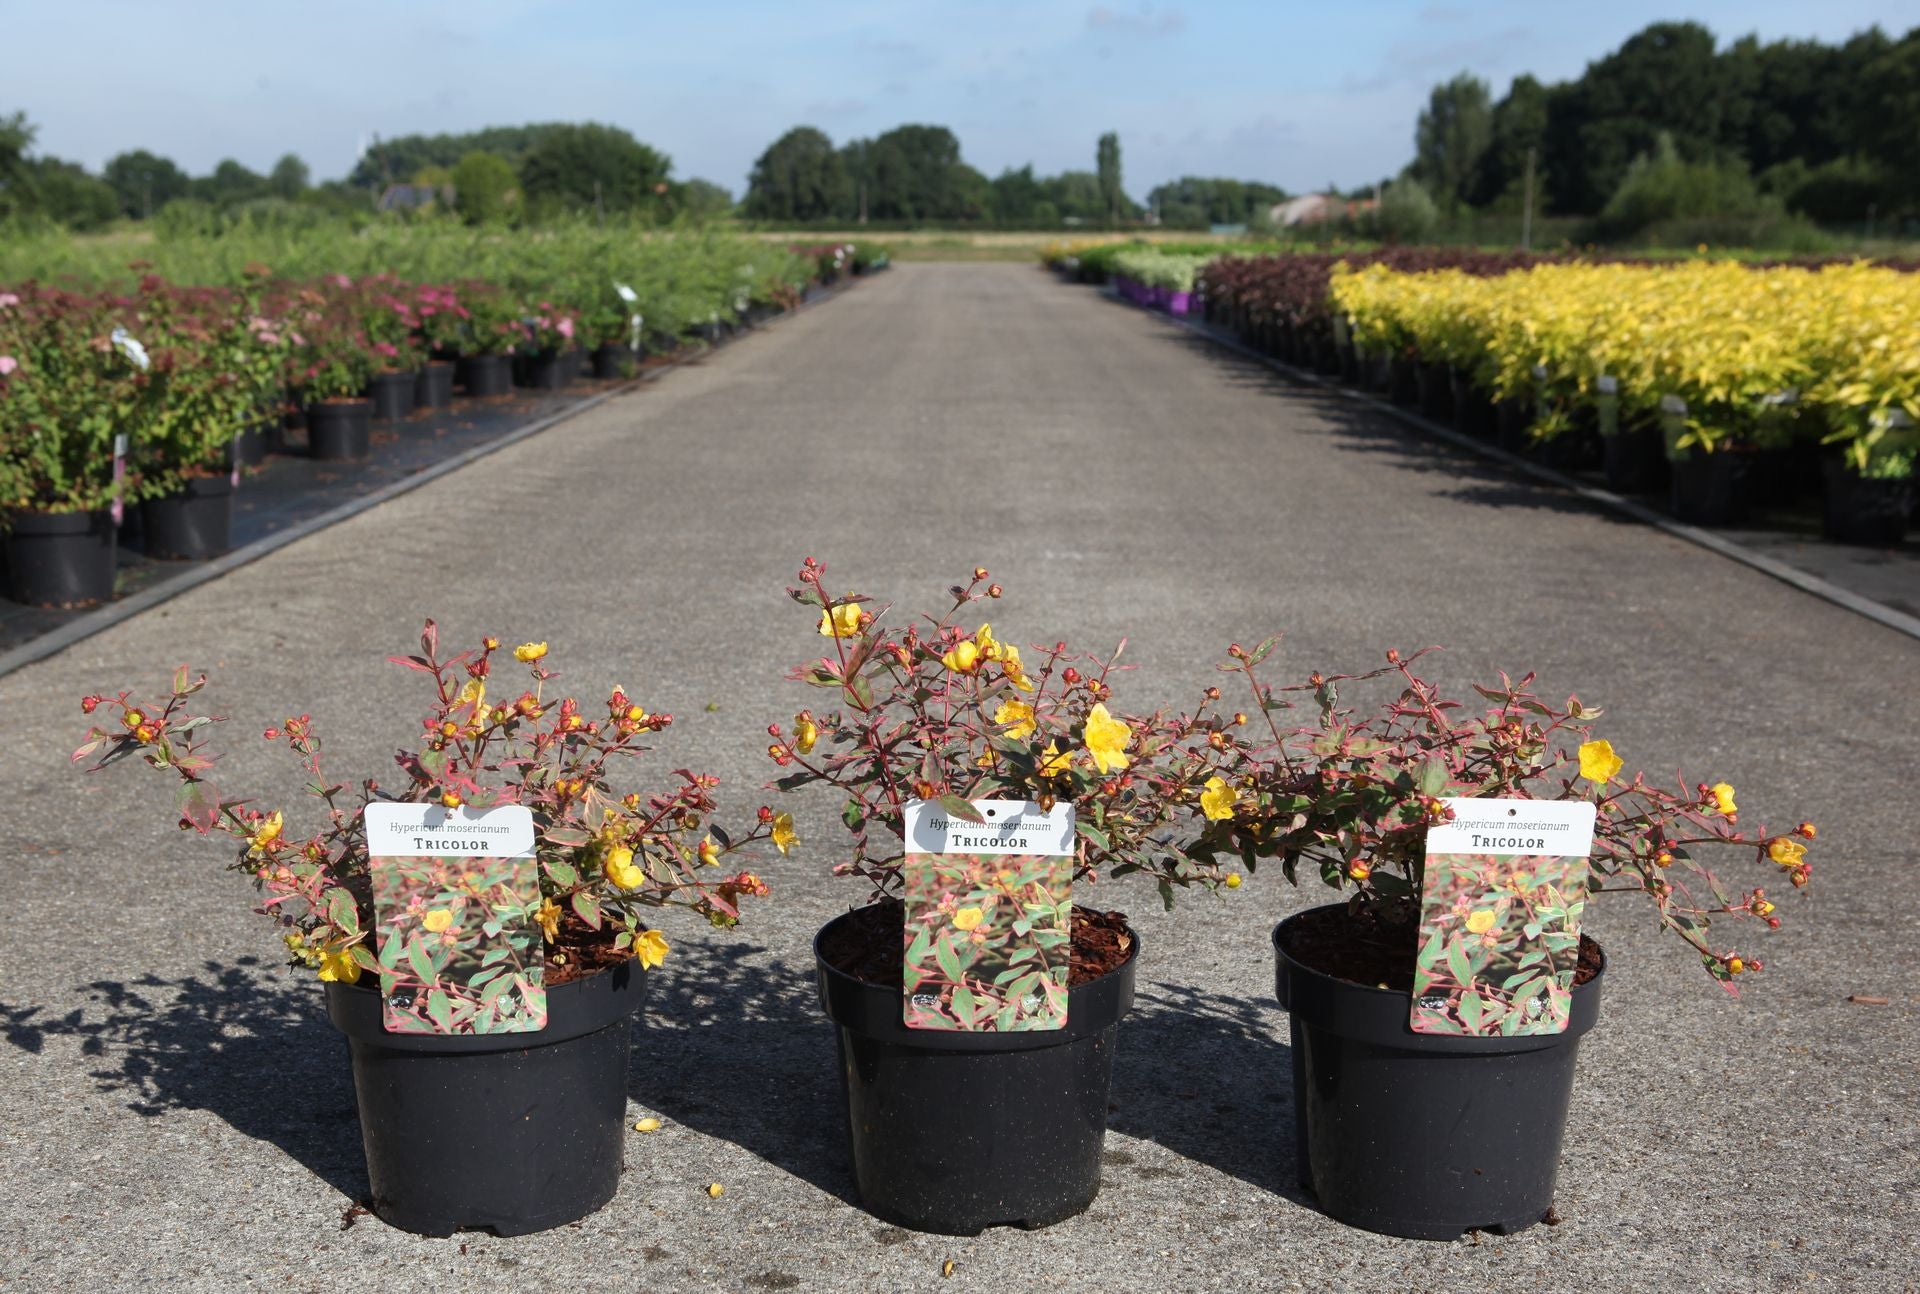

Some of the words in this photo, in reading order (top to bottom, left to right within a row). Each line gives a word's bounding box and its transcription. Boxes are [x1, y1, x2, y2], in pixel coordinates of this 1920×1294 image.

[390, 822, 445, 834] Hypericum
[447, 823, 510, 834] moserianum
[929, 818, 985, 831] Hypericum
[987, 820, 1052, 831] moserianum
[1451, 818, 1505, 830] Hypericum
[1507, 820, 1570, 831] moserianum
[413, 837, 489, 850] TRICOLOR
[952, 834, 1028, 848] TRICOLOR
[1472, 834, 1545, 848] TRICOLOR
